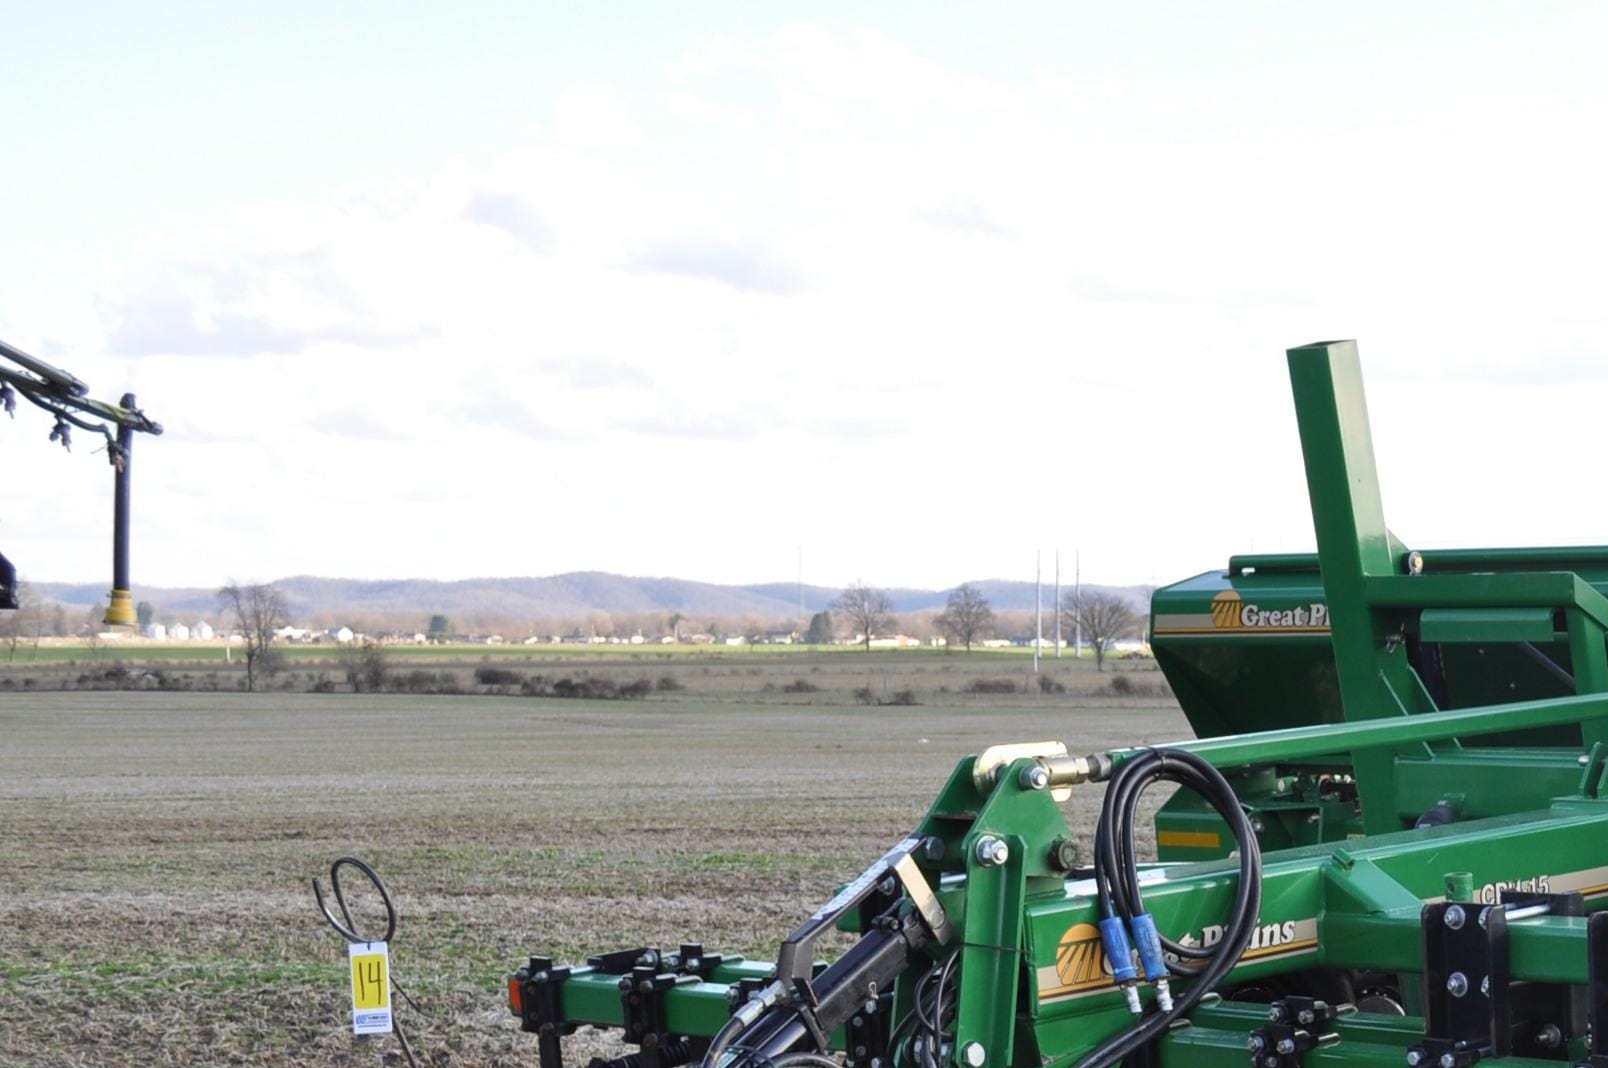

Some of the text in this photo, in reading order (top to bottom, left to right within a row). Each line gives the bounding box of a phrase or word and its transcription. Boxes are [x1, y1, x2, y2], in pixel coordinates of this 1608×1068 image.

[1241, 604, 1304, 627] Great
[1201, 919, 1295, 952] Pins
[358, 961, 383, 1005] 14
